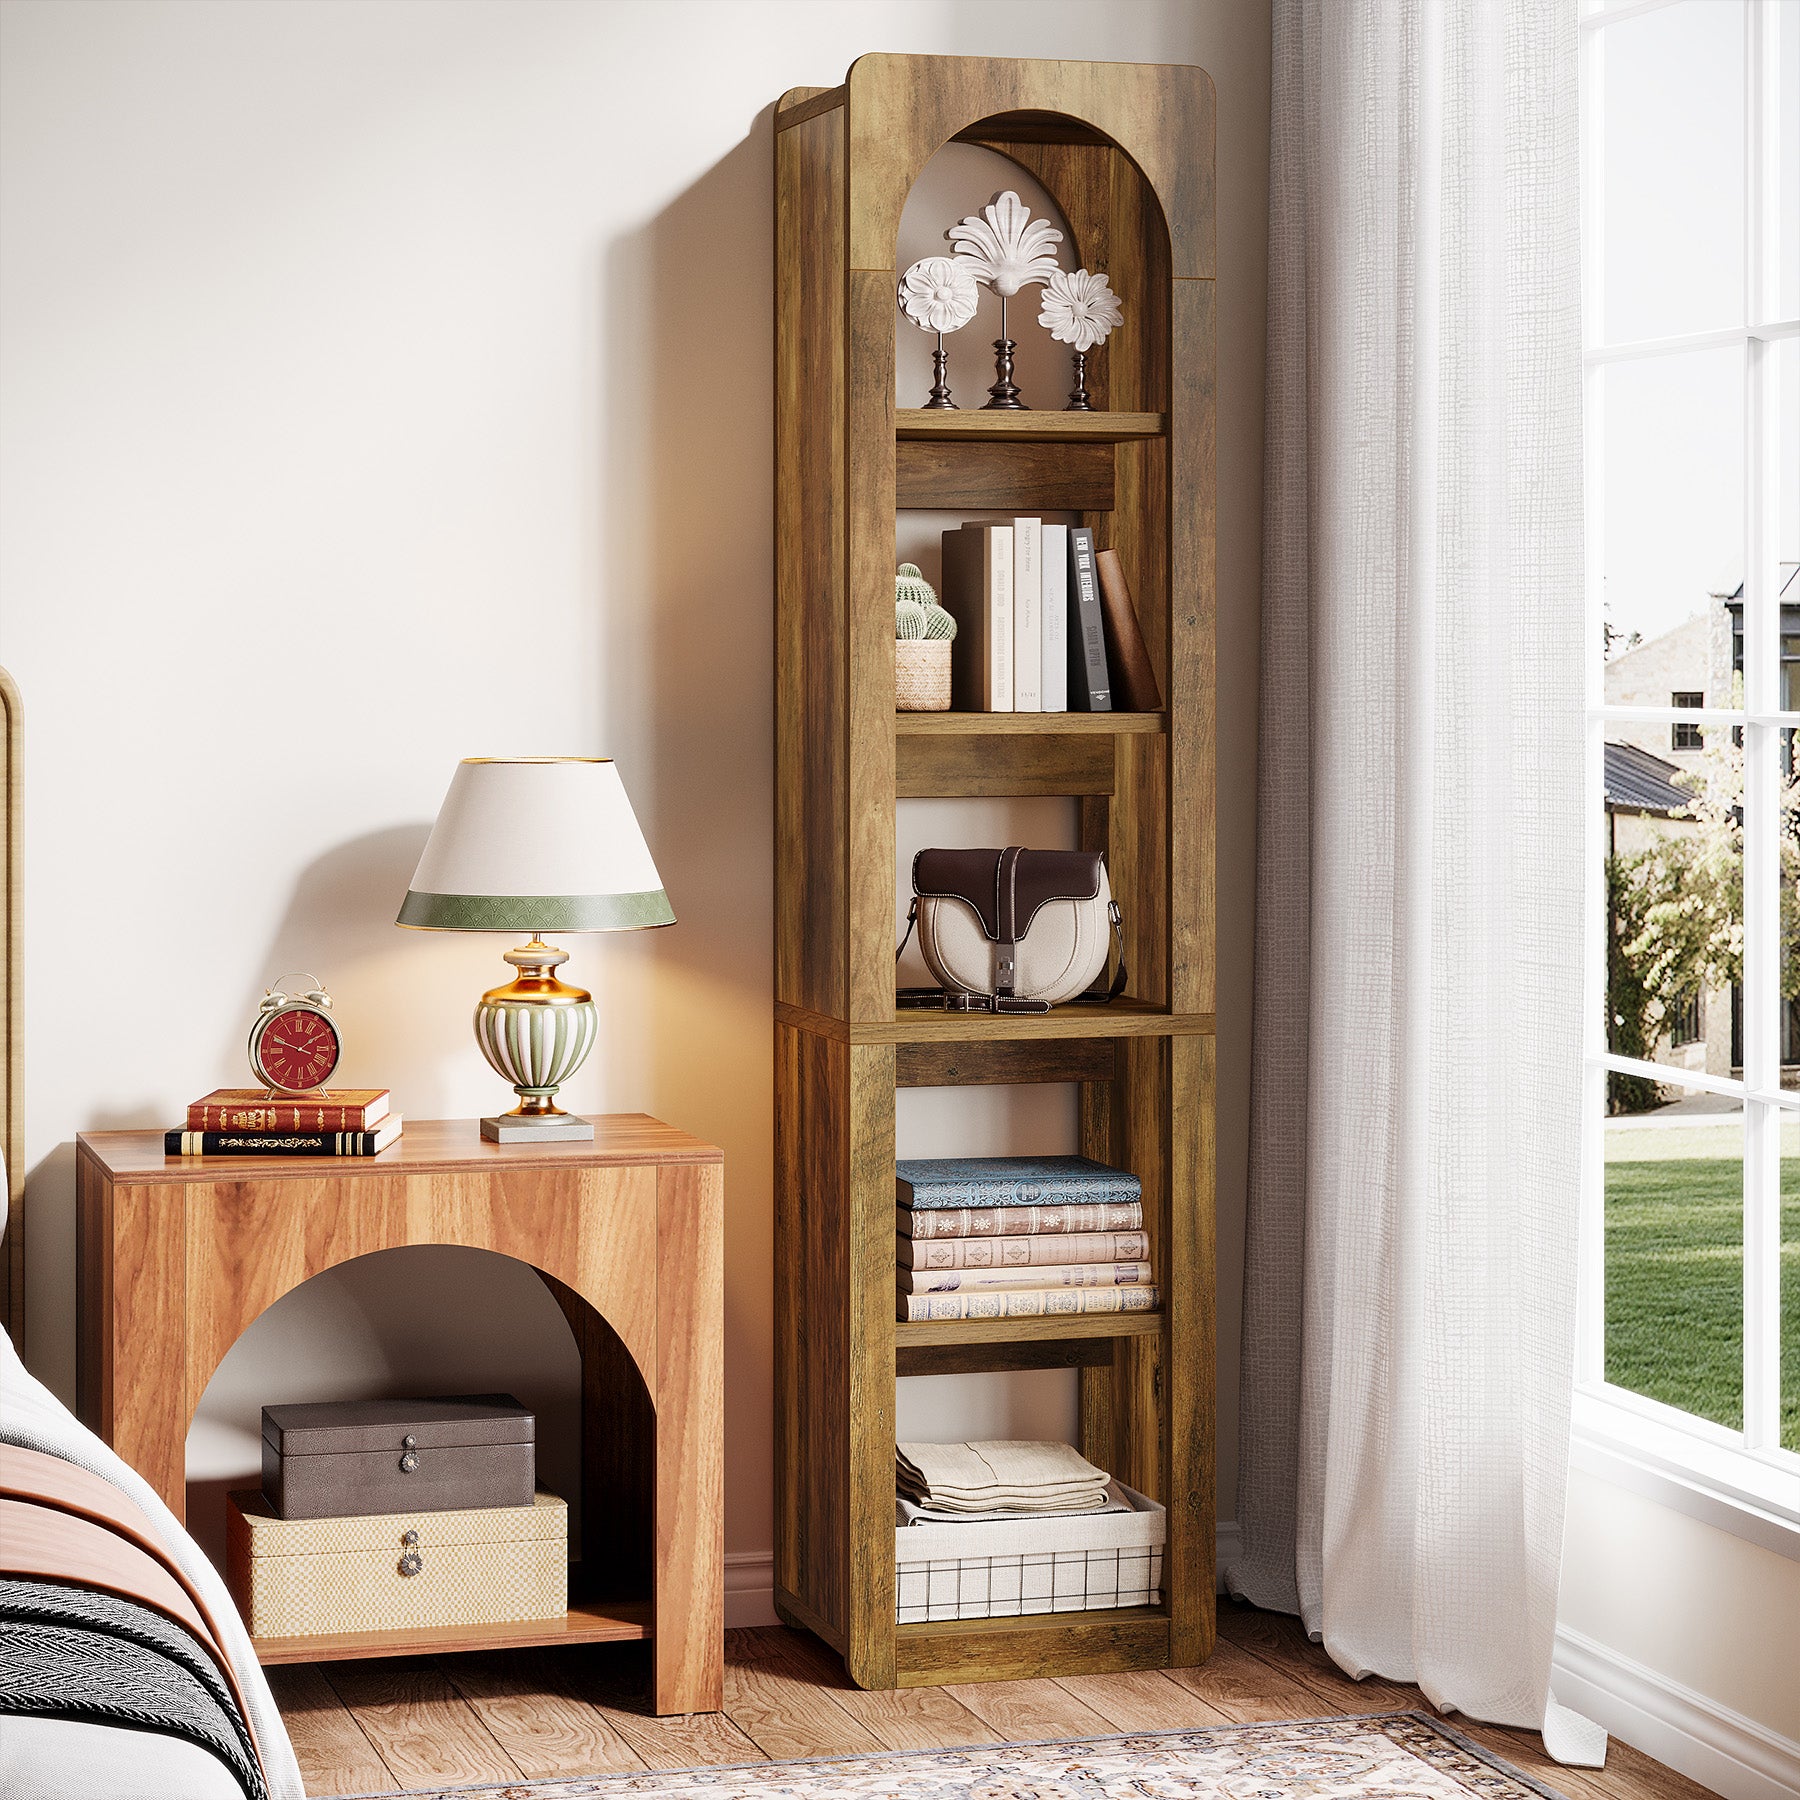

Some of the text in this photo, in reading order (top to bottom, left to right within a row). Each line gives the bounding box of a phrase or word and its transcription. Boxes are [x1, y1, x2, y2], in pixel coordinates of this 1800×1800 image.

[1076, 537, 1094, 602] NEW YORK INTERIORS
